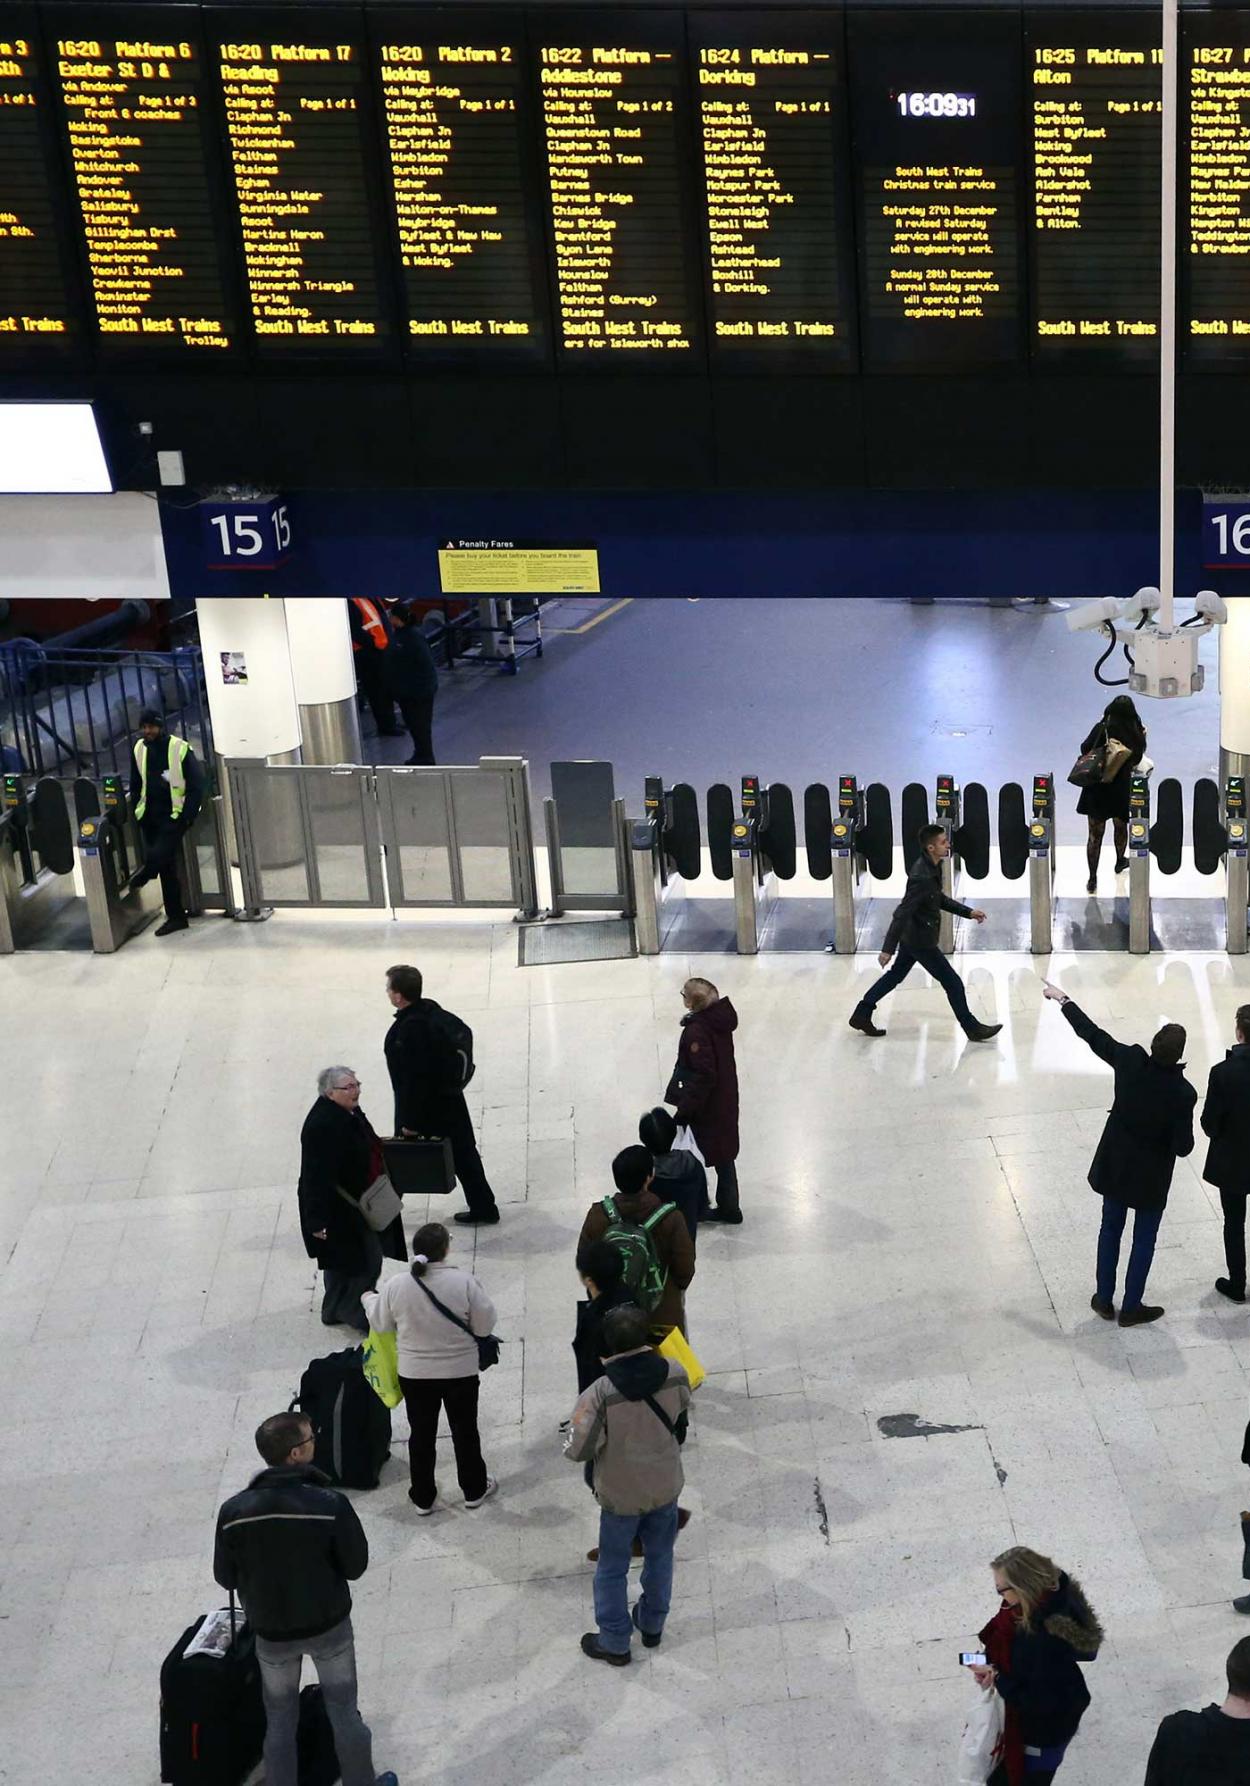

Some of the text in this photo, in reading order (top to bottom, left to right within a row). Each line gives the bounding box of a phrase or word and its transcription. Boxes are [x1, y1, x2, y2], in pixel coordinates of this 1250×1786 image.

[57, 41, 101, 56] 16:20
[179, 43, 191, 58] 6
[220, 44, 262, 60] 16:20
[336, 46, 350, 60] 17
[381, 46, 422, 61] 16:20
[501, 47, 511, 62] 2
[1193, 48, 1233, 63] 16:27
[700, 49, 740, 63] 16:24
[1035, 49, 1075, 64] 16:25
[58, 61, 113, 77] Exeter
[221, 67, 279, 82] Reading
[381, 66, 430, 83] Woking
[541, 68, 622, 83] Addlestone
[699, 69, 755, 86] Dorking
[139, 95, 196, 108] Page 1 of 3
[70, 135, 141, 147] Basingstoke
[72, 148, 119, 158] Overton
[234, 164, 279, 174] Staines
[896, 167, 982, 176] South West Trains
[884, 180, 996, 189] Christmas train service
[238, 191, 288, 202] Virginia
[81, 201, 139, 213] Salisbury
[553, 206, 601, 215] Chiswick
[883, 206, 997, 217] Saturday 27th December
[905, 219, 941, 228] revised
[944, 219, 986, 230] Saturday
[555, 231, 611, 241] Brentford
[894, 232, 929, 240] service
[951, 232, 989, 241] operate
[891, 244, 910, 253] with
[914, 244, 965, 255] engineering
[711, 258, 780, 267] Leatherhead
[891, 270, 923, 281] Sunday
[951, 269, 993, 279] December
[929, 282, 961, 293] Sunday
[964, 282, 999, 291] service
[923, 296, 959, 305] operate
[963, 295, 982, 304] with
[904, 307, 956, 318] engineering
[99, 318, 221, 332] South West Trains
[409, 320, 529, 334] South West Trains
[272, 506, 290, 550] 15
[211, 515, 262, 555] 15
[459, 541, 514, 549] Penalty Fares
